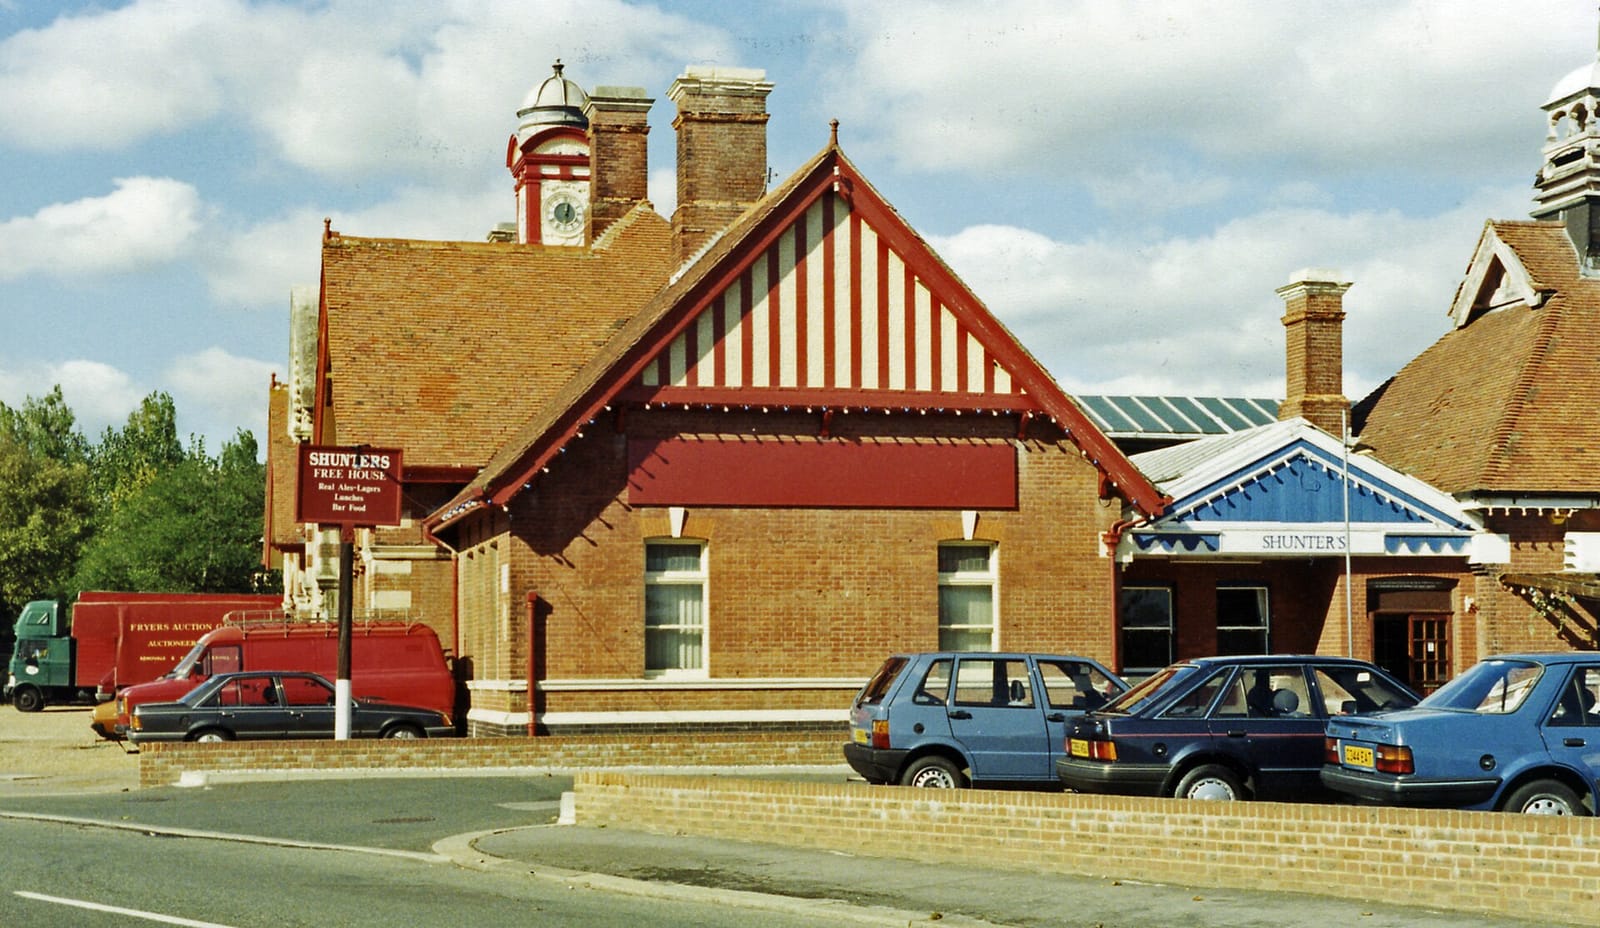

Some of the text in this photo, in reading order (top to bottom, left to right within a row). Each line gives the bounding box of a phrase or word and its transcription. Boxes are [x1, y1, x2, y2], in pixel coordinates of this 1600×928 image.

[309, 452, 390, 469] SHUNTERS
[313, 468, 387, 480] FREE HOUSE
[318, 482, 335, 491] Real
[334, 493, 364, 502] Lunches
[332, 503, 366, 512] Bar Food
[130, 623, 170, 632] FRYERS
[172, 623, 212, 631] AUCTION
